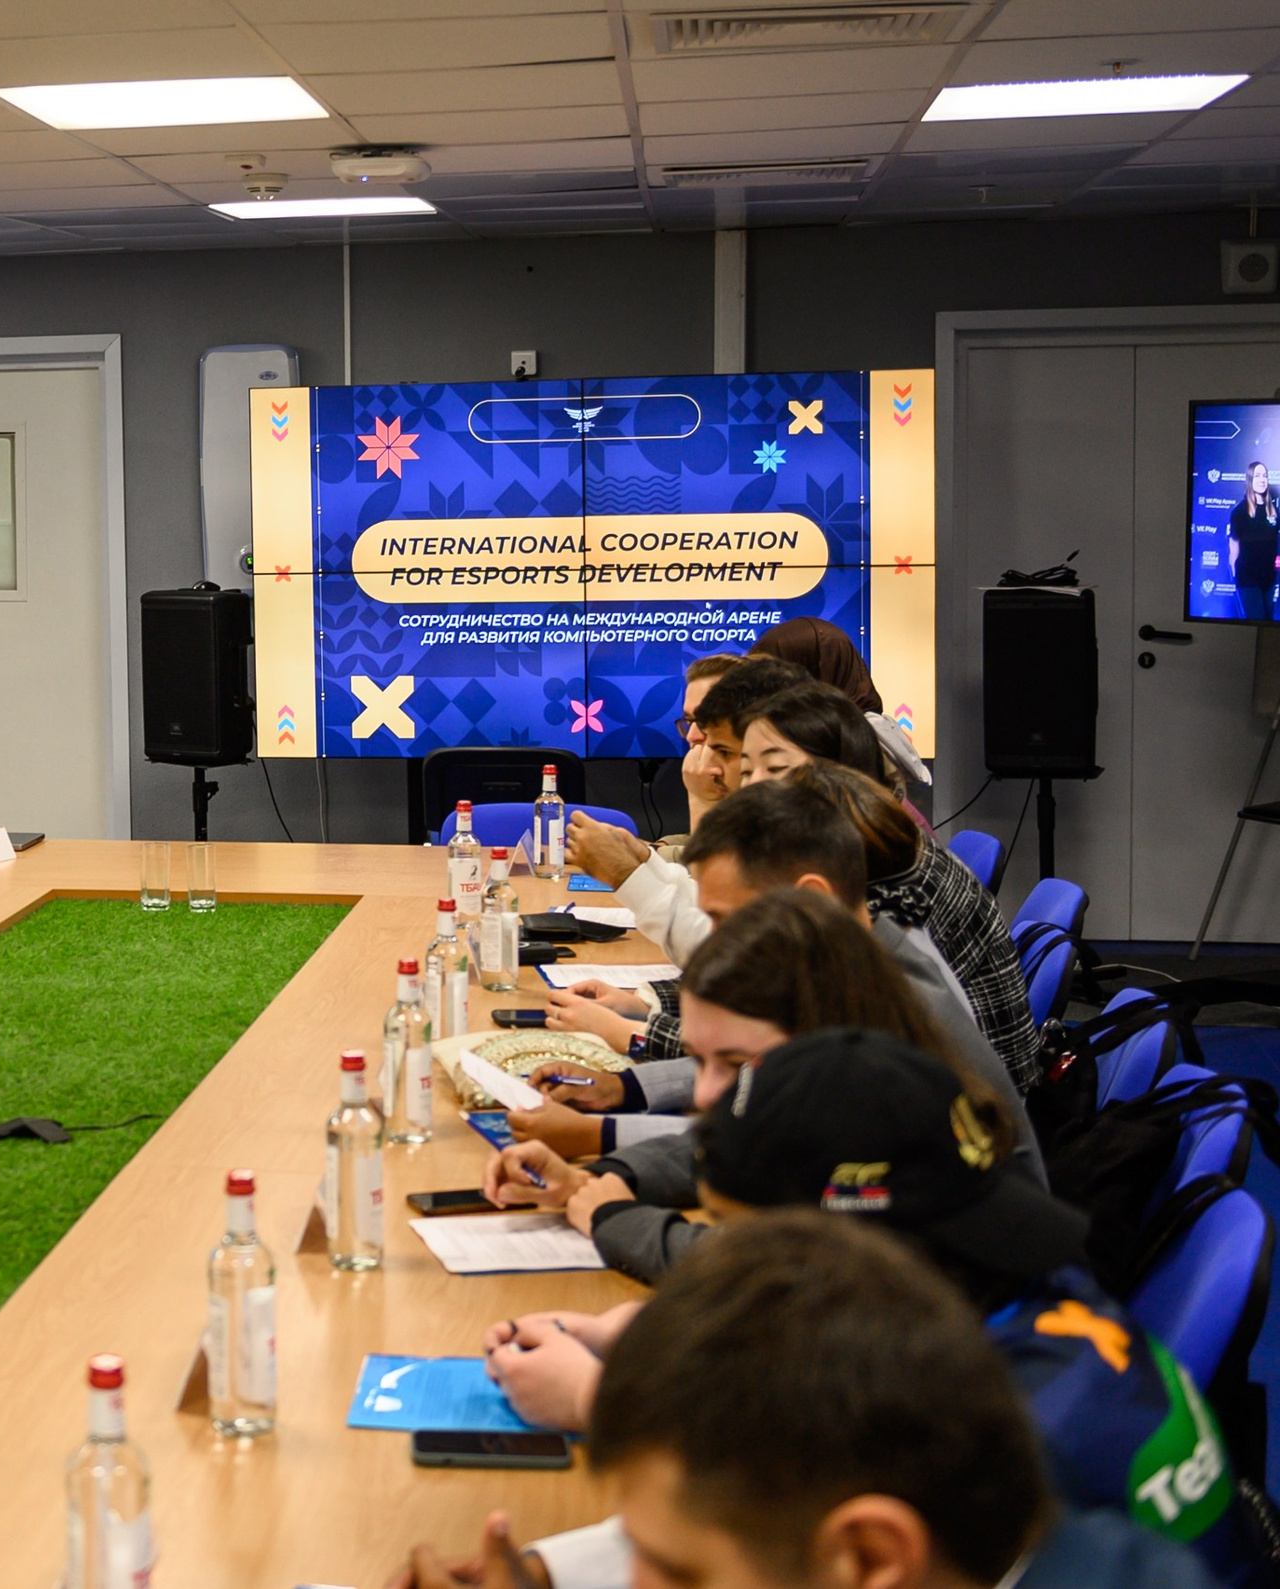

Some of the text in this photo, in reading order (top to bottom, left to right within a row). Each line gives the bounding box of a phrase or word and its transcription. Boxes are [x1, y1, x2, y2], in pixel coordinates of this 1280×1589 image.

[380, 531, 799, 556] INTERNATIONAL COOPERATION
[390, 562, 783, 586] FOR ESPORTS DEVELOPMENT
[398, 608, 781, 629] СОТРУДНИЧЕСТВО НА МЕЖДУНАРОДНОЙ АРЕНЕ
[421, 628, 756, 646] ДЛЯ РАЗВИТИЯ КОМПЬЮТЕРНОГО СПОРТА
